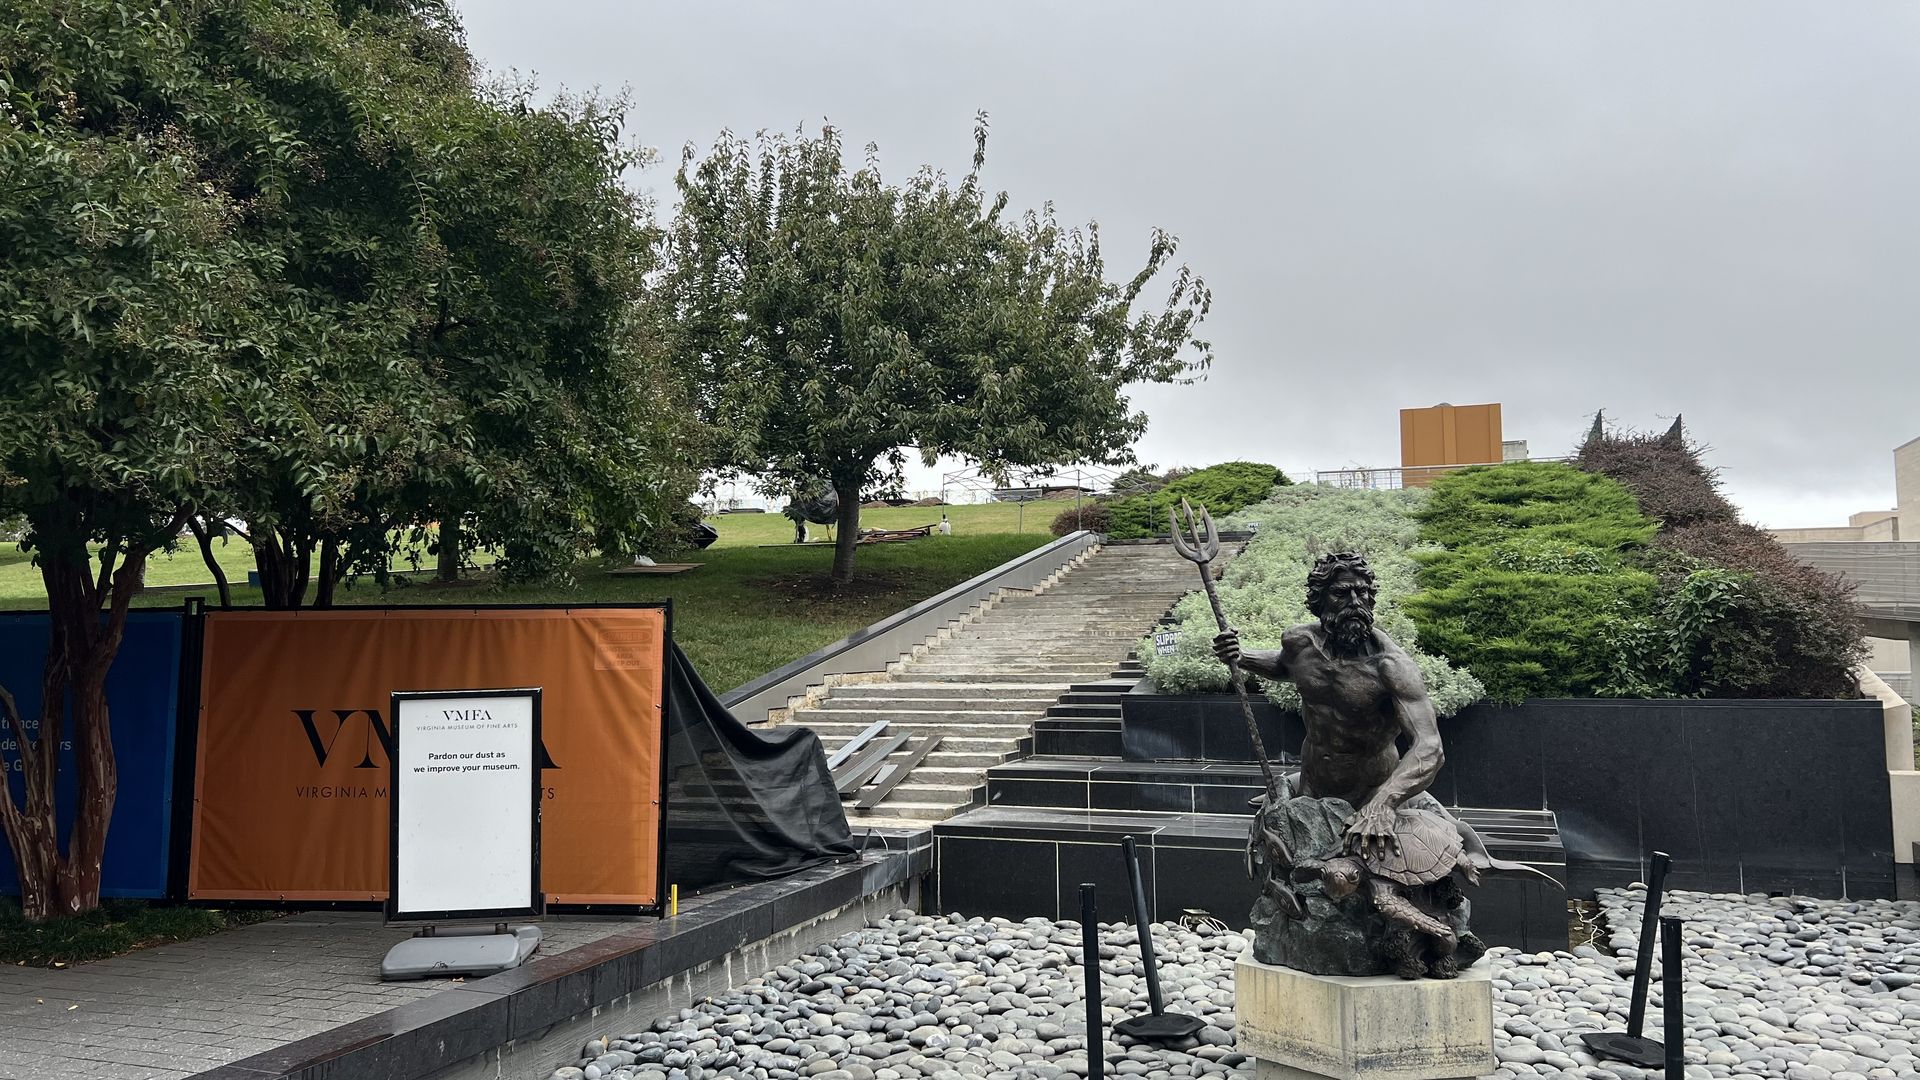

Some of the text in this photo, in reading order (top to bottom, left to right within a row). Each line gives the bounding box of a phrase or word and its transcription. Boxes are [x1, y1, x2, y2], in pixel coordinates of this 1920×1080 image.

[443, 709, 492, 721] VMFA
[427, 765, 460, 773] improve
[462, 765, 480, 773] your
[296, 786, 368, 798] VIRGINIA
